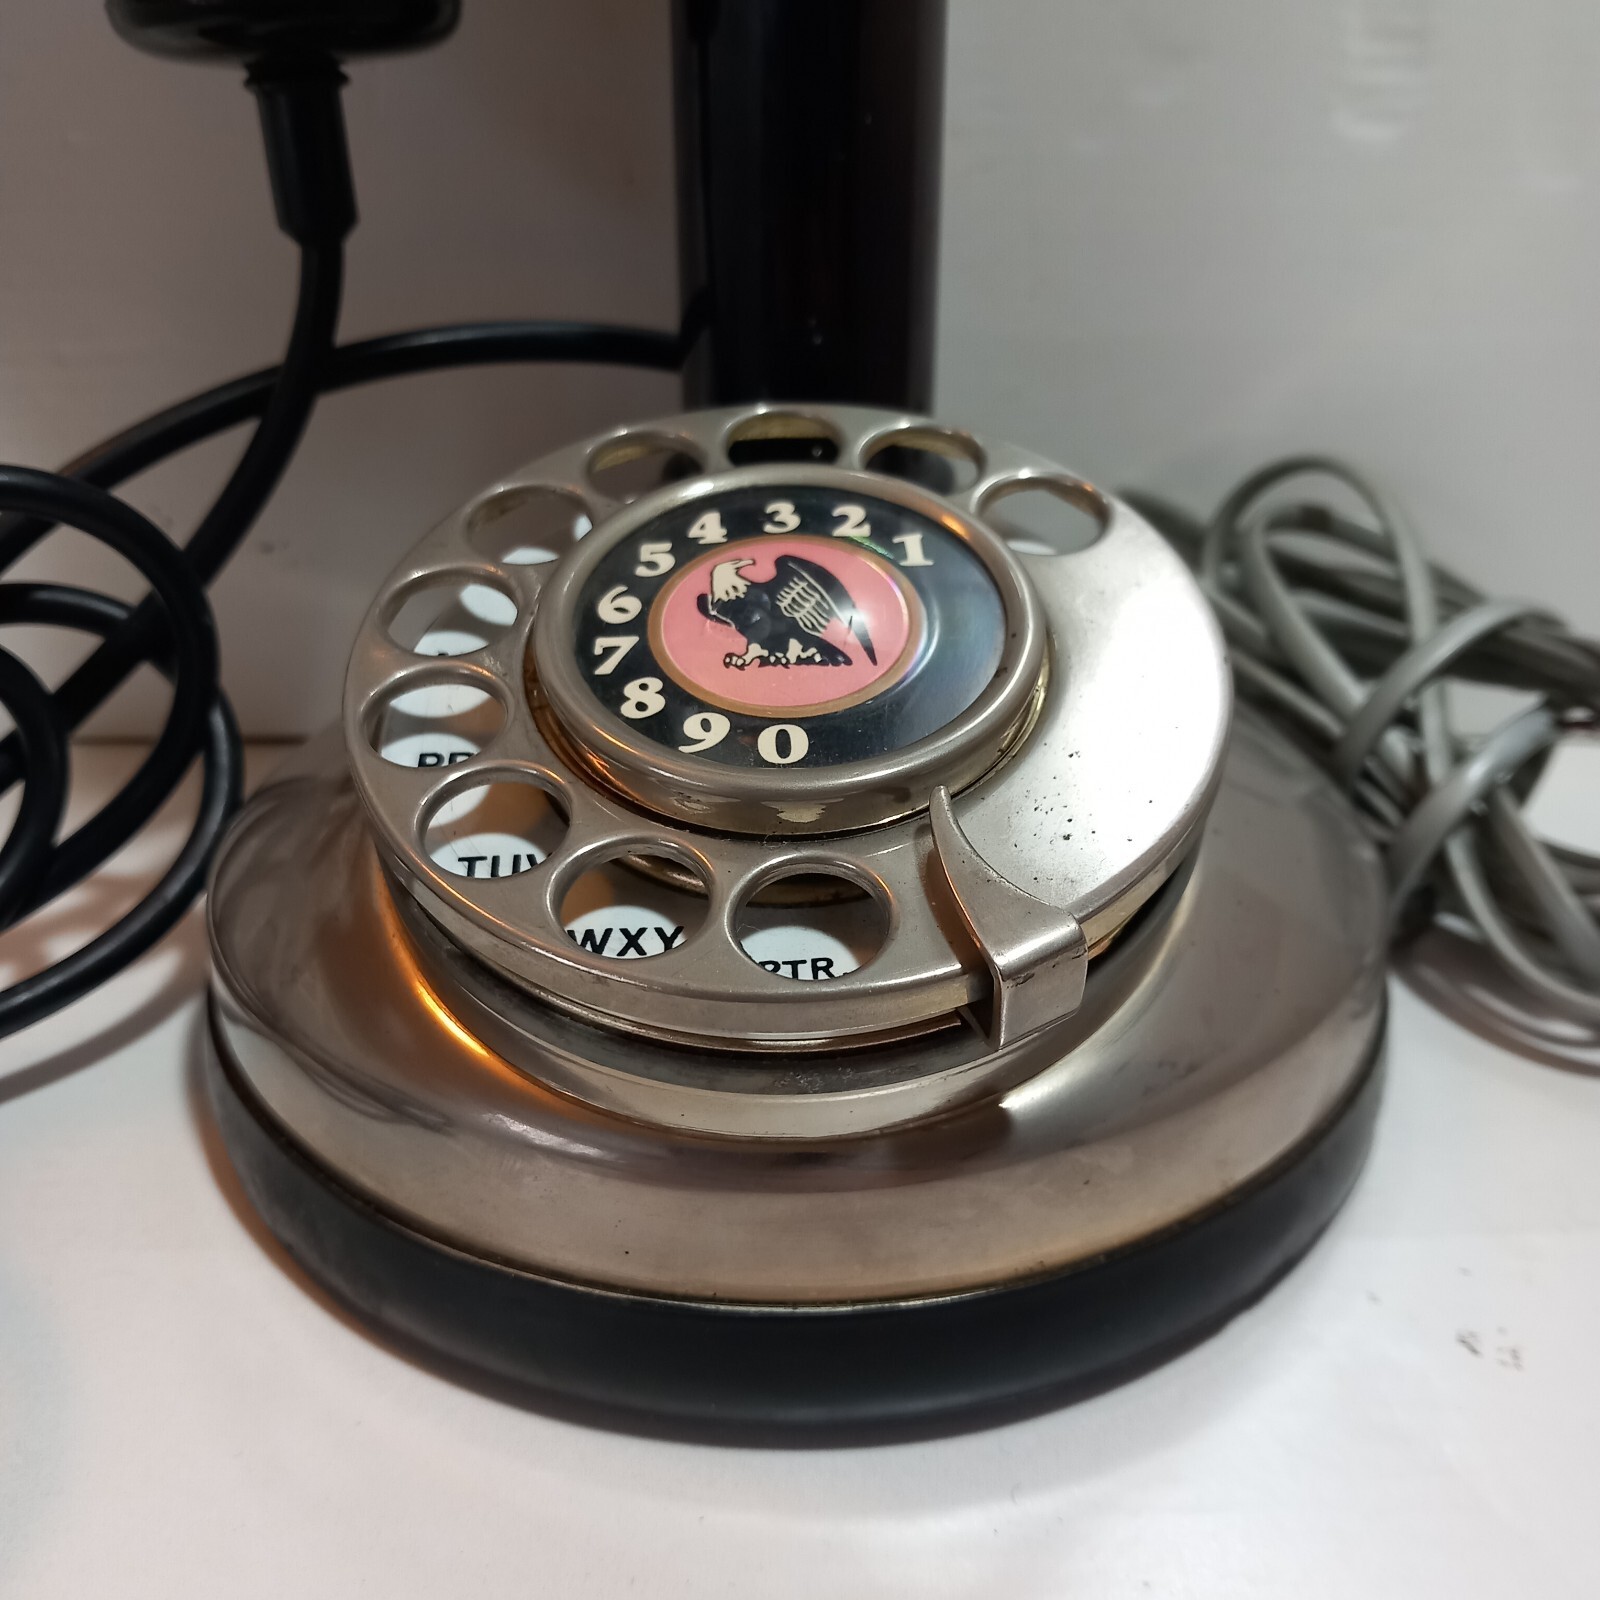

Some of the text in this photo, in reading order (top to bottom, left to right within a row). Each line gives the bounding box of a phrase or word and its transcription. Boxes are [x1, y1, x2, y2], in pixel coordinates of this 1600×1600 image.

[688, 511, 728, 545] 4
[763, 501, 801, 534] 3
[832, 504, 871, 537] 2
[635, 542, 676, 577] 5
[892, 531, 935, 567] 1
[597, 585, 643, 624] 6
[593, 635, 640, 675] 7
[620, 676, 666, 719] 8
[678, 712, 731, 754] 9
[757, 724, 809, 765] 0
[566, 925, 685, 957] WXY
